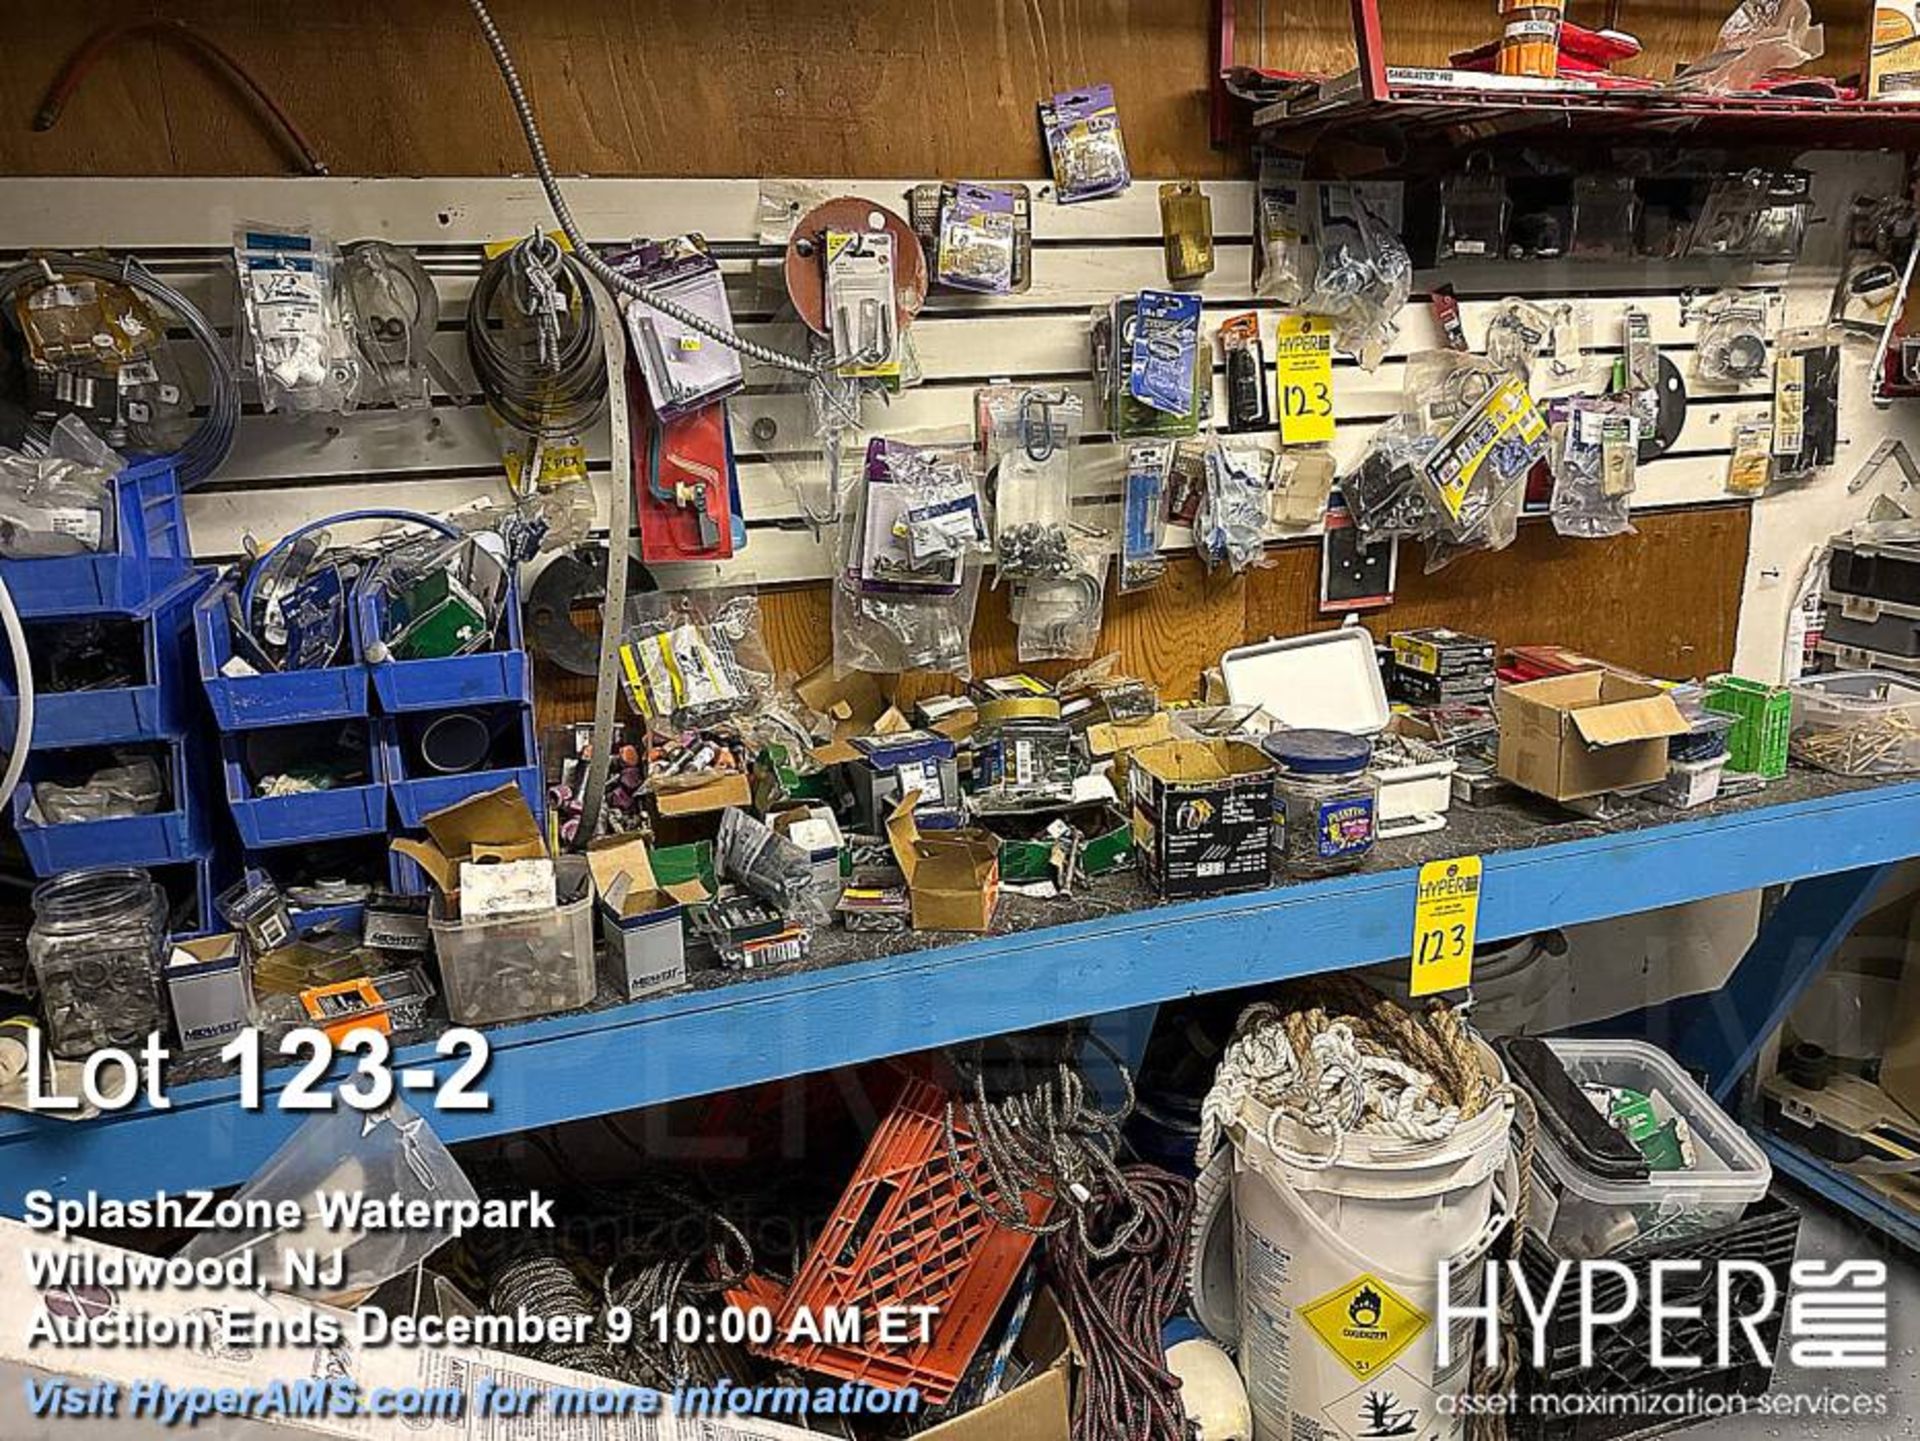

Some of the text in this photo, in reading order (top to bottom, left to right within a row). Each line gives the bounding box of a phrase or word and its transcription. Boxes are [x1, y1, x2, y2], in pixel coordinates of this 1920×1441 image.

[1279, 334, 1317, 353] HYPER
[1284, 382, 1333, 416] 123
[1419, 876, 1466, 899] HYPER
[1418, 923, 1467, 966] 123
[184, 1020, 241, 1041] MIDWEST
